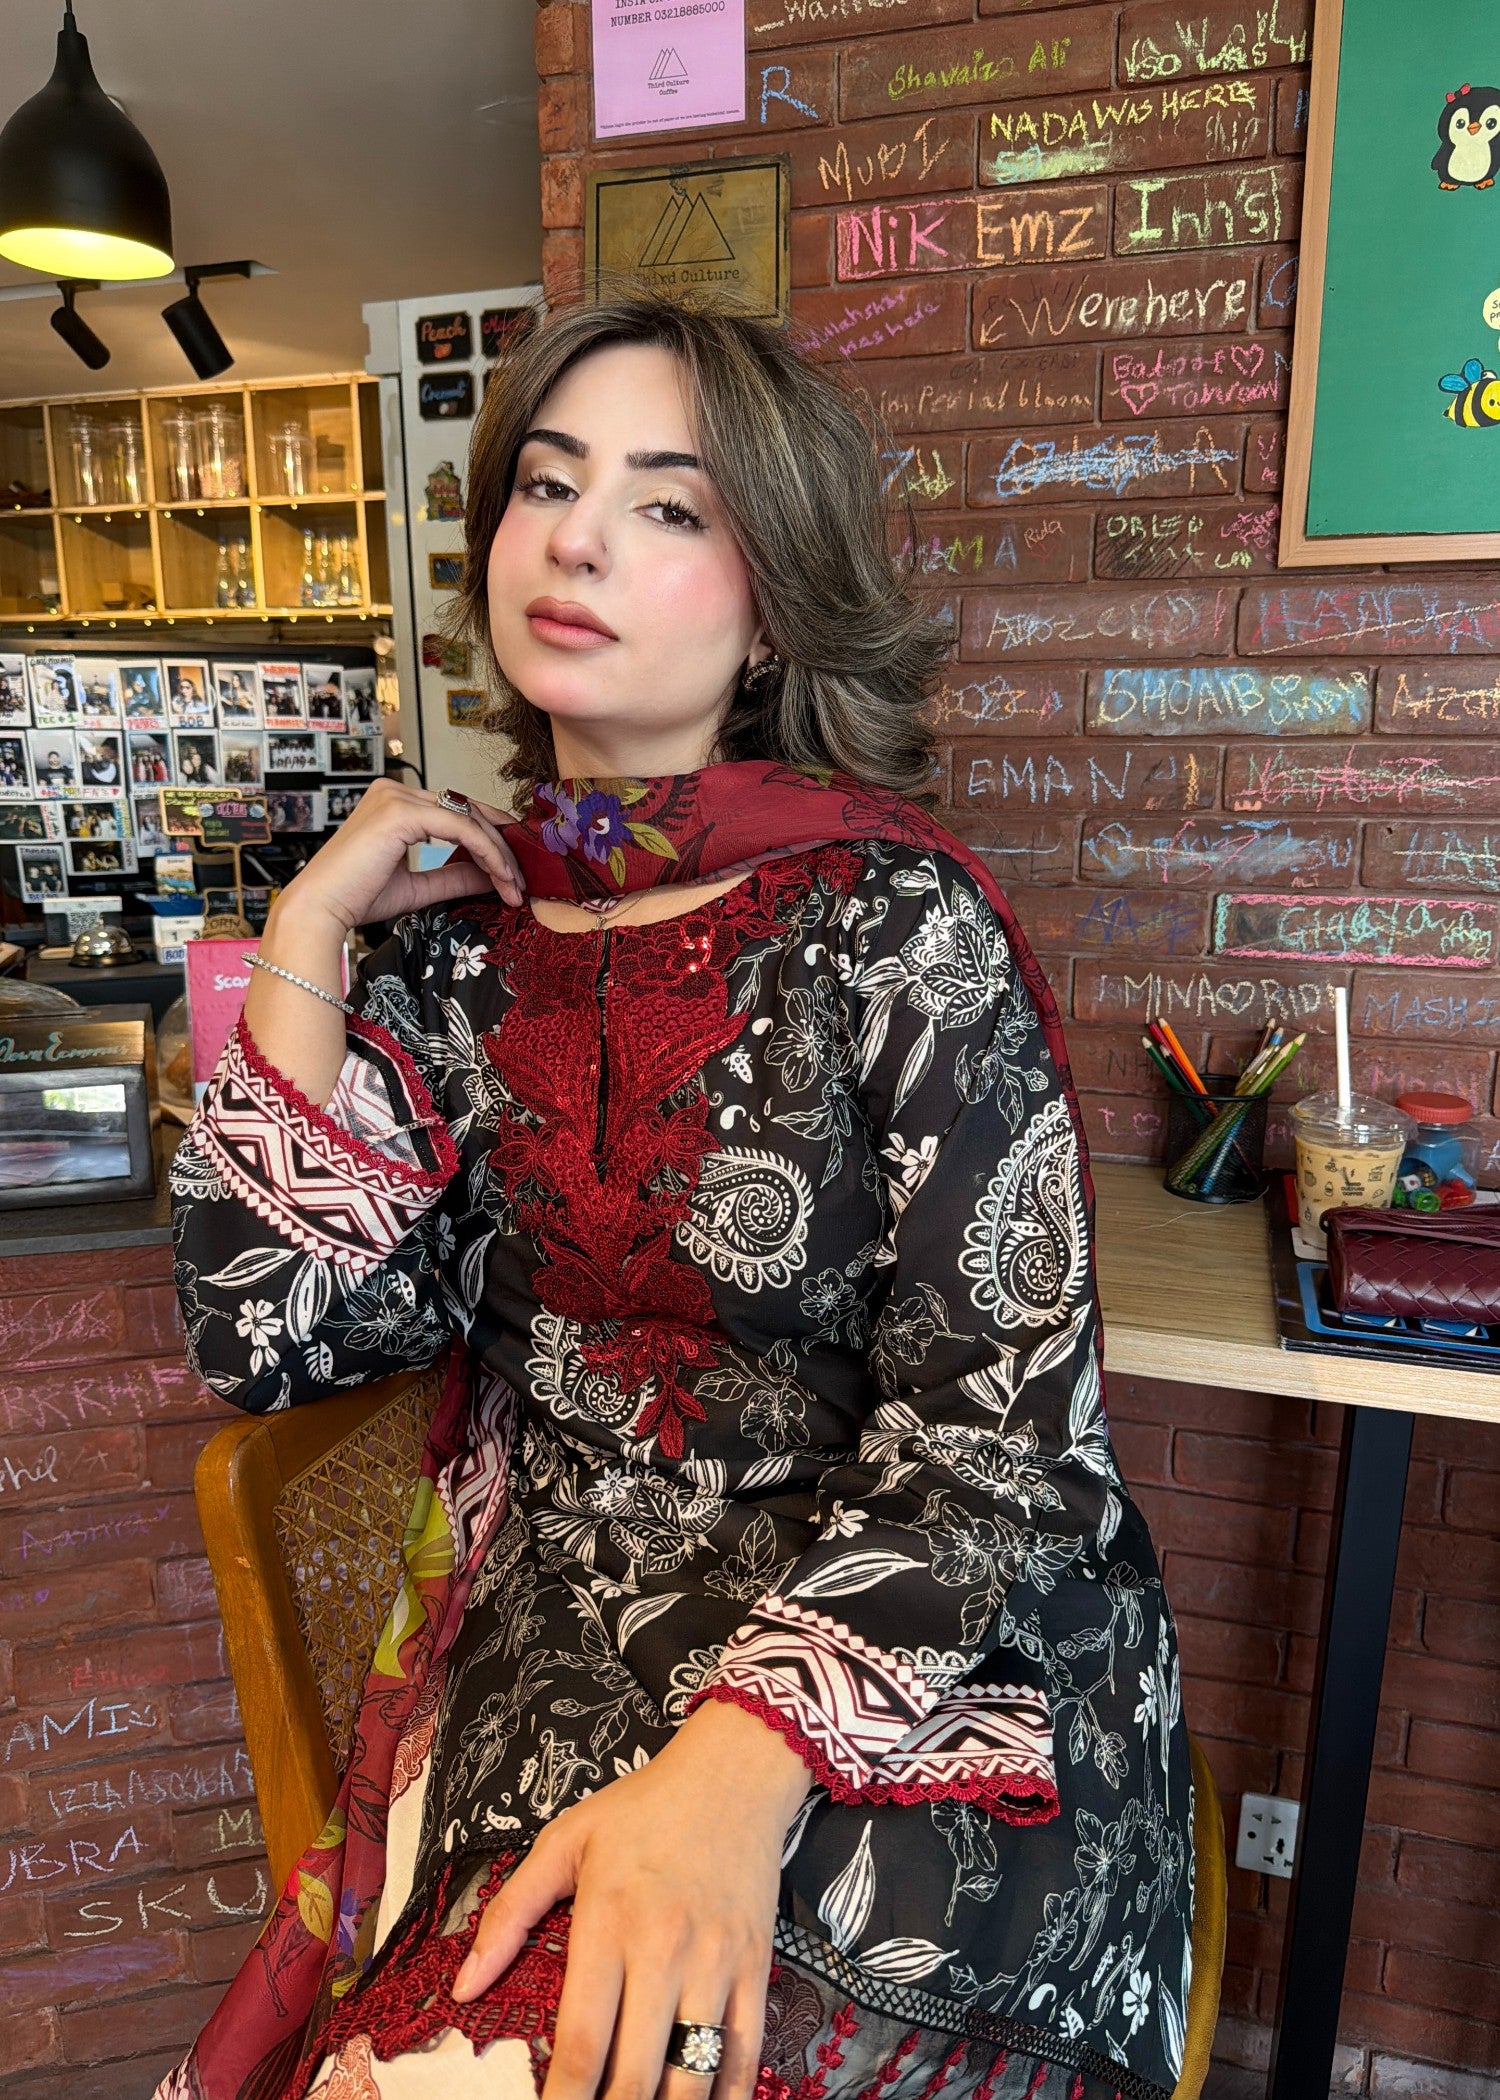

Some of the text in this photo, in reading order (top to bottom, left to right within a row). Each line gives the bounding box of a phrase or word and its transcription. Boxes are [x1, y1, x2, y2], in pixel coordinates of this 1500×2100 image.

[610, 1, 725, 27] NUMBER 03218885000
[1028, 37, 1072, 74] Ali
[648, 79, 690, 90] Third Culture
[659, 88, 679, 96] Coffee
[759, 66, 820, 125] R
[1092, 98, 1153, 130] WAS
[1161, 81, 1257, 122] HERE
[680, 268, 741, 284] Culture
[421, 315, 467, 343] Peach
[1023, 519, 1065, 549] Rida
[968, 751, 1133, 804] EMAN
